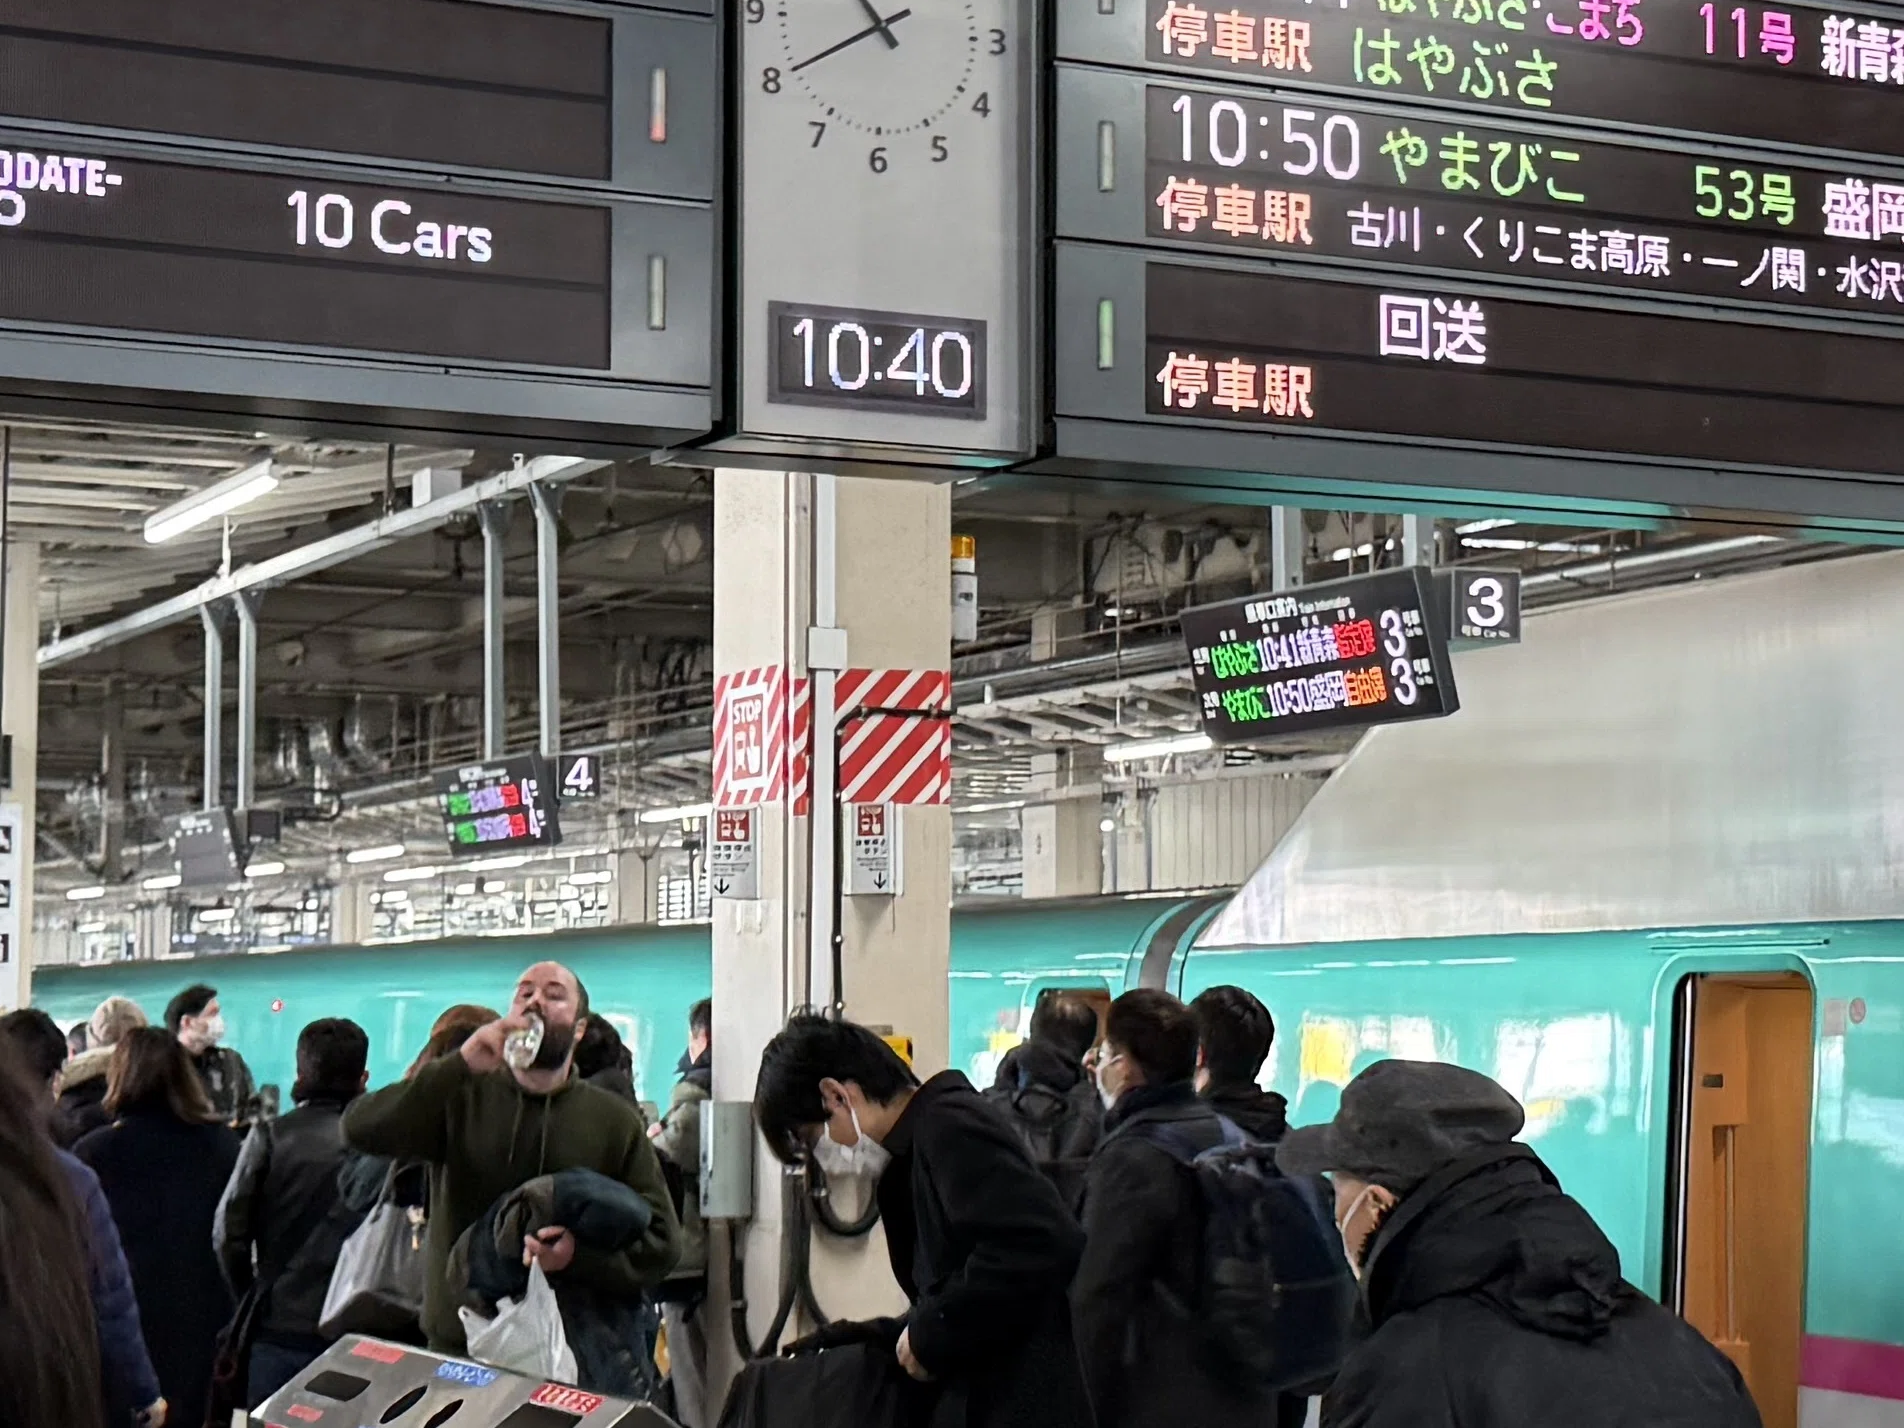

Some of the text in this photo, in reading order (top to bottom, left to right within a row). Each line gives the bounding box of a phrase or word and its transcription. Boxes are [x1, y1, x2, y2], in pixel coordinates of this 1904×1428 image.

[988, 28, 1007, 56] 3
[1156, 1, 1558, 108] 停車駅 はやぶさ
[1699, 2, 1796, 66] 11号
[762, 67, 781, 93] 8
[972, 92, 991, 118] 4
[808, 121, 826, 148] 7
[931, 135, 948, 162] 5
[869, 147, 888, 173] 6
[1171, 94, 1360, 182] 10:50
[1378, 127, 1586, 203] やまびこ
[1695, 165, 1796, 227] 53号
[288, 190, 493, 264] 10 Cars
[1156, 176, 1313, 246] 停車駅
[1378, 294, 1487, 365] 回送
[793, 318, 971, 398] 10:40
[1156, 352, 1314, 419] 停車駅
[1467, 577, 1504, 627] 3
[1257, 634, 1299, 671] 10:41
[1380, 609, 1406, 657] 3
[1267, 677, 1313, 717] 10:50
[1391, 658, 1416, 705] 3
[733, 699, 762, 725] STOP
[565, 757, 593, 791] 4
